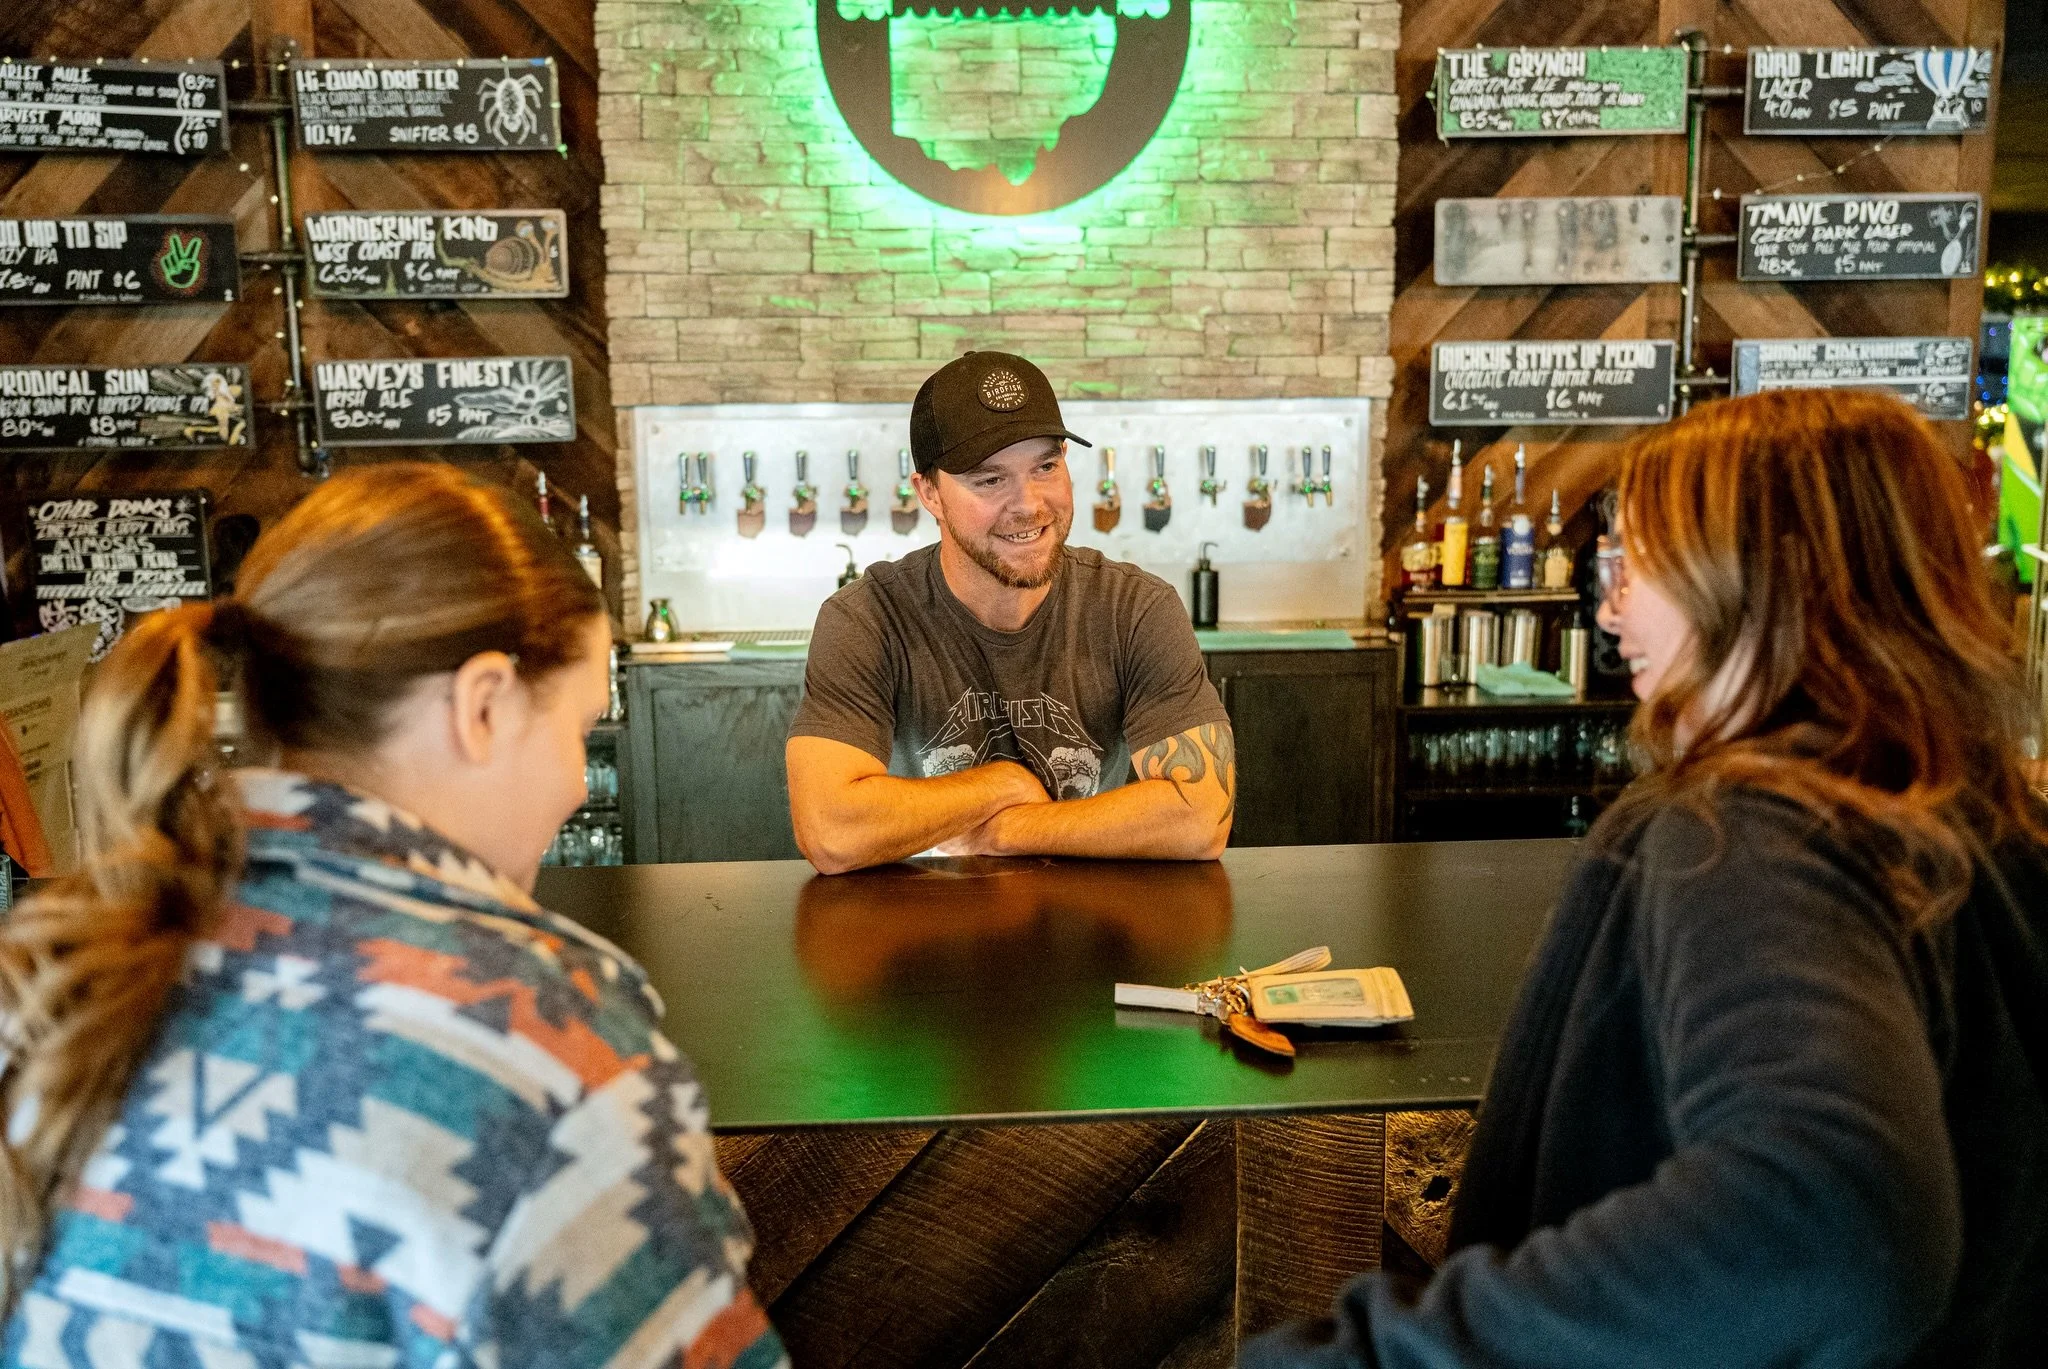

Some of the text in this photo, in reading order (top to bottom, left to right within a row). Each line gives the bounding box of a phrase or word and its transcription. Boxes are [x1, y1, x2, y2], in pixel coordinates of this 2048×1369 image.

[51, 66, 92, 83] MULE
[1445, 51, 1586, 79] THE GRYNCH
[1754, 51, 1880, 79] BIRD LIGHT
[380, 69, 460, 90] DRIFTER
[1759, 78, 1813, 100] LAGER
[57, 110, 102, 127] MOON
[1829, 98, 1859, 120] $5
[1867, 101, 1906, 121] PINT
[389, 125, 452, 143] SNIFTER
[453, 124, 479, 144] $8
[1747, 200, 1900, 227] TMAVE PIVO
[60, 220, 91, 249] TO
[94, 221, 128, 249] SIP
[305, 215, 499, 243] WANDERING KIND
[1812, 224, 1860, 242] DARK
[1863, 223, 1913, 241] LAGER
[33, 247, 59, 266] IPA
[313, 241, 436, 263] WEST COAST IPA
[65, 269, 104, 290] PINT
[404, 262, 433, 281] $6
[1580, 344, 1602, 369] OF
[1605, 344, 1657, 369] MIND
[0, 369, 150, 397] RODIGAL SUN
[436, 361, 514, 389] FINEST
[326, 388, 414, 410] IRISH ALE
[986, 384, 1023, 399] BIRDFISH
[1546, 388, 1572, 410] $6
[427, 404, 452, 427] $5
[458, 407, 493, 425] PINT
[38, 498, 172, 522] OTHER DRINKS
[54, 536, 155, 554] MIMOSAS
